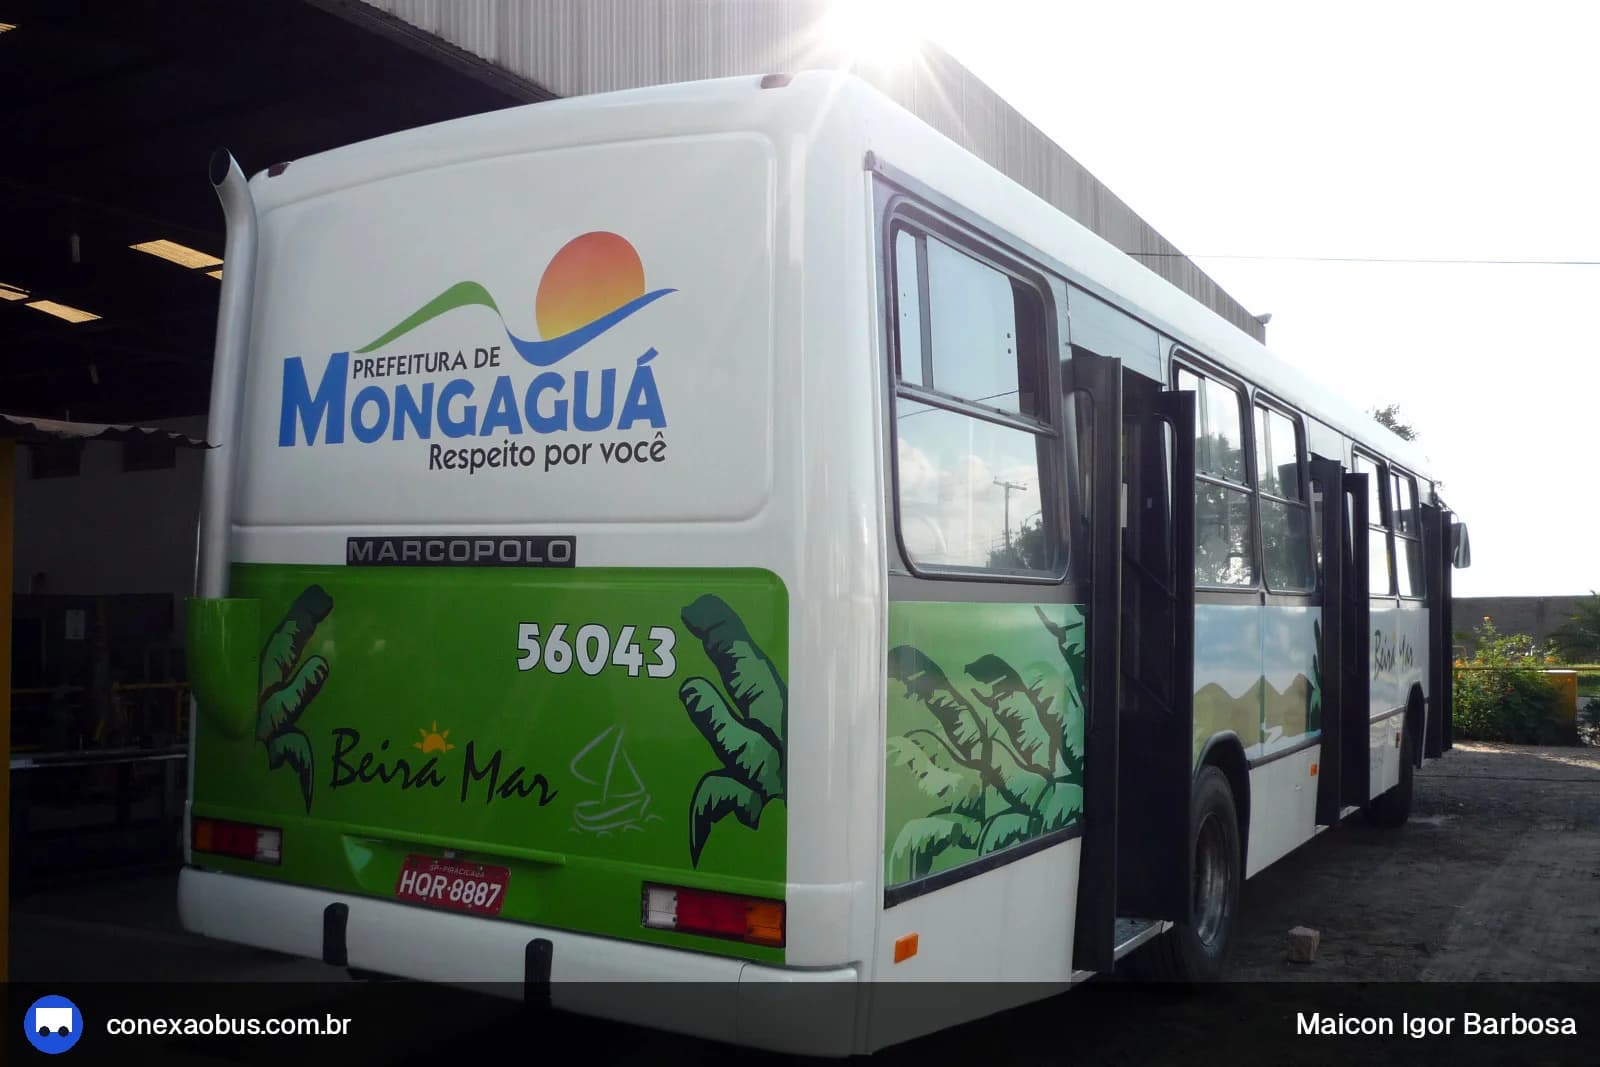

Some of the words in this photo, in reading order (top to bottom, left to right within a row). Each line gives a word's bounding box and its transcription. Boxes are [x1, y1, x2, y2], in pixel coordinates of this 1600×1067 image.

[352, 350, 468, 379] PREFEITURA
[474, 346, 501, 368] DE
[278, 347, 668, 447] MONGAGUÁ
[429, 440, 536, 475] Respeito
[544, 441, 593, 472] por
[600, 431, 668, 464] você
[347, 539, 573, 564] MARCOPOLO
[516, 622, 678, 679] 56043
[329, 728, 447, 790] Beira
[460, 740, 559, 807] Mar
